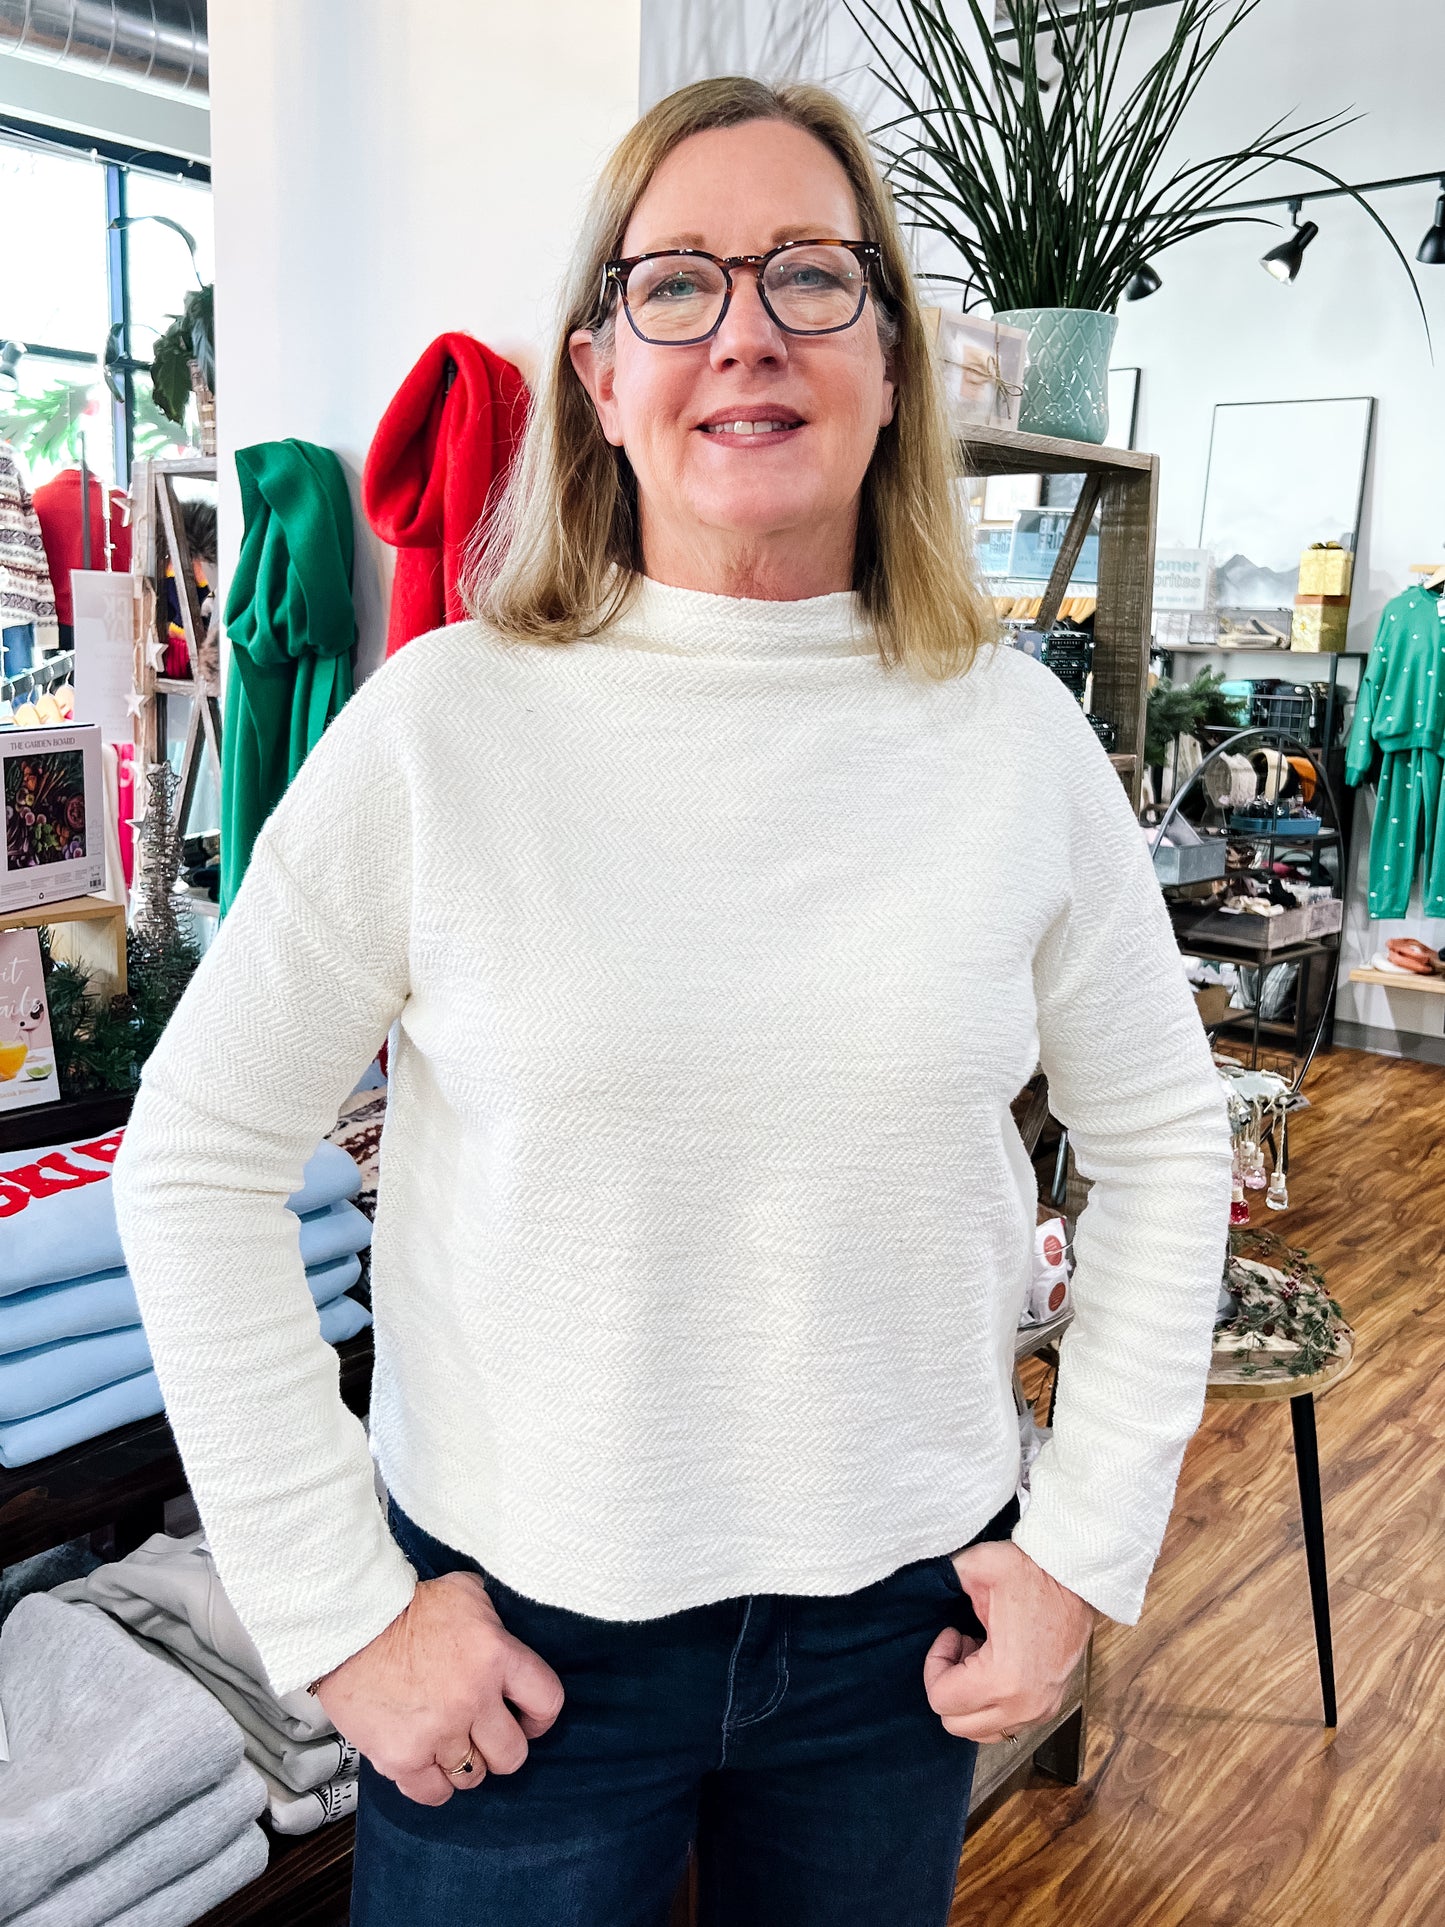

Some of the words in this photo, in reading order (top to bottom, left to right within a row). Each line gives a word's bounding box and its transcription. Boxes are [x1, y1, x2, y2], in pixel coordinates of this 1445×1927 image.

[1039, 517, 1071, 534] BLA
[1155, 559, 1201, 573] omer
[1154, 572, 1201, 589] orites
[10, 741, 23, 750] THE
[24, 739, 52, 749] GARDEN
[53, 737, 76, 746] BOARD
[0, 957, 30, 985] it
[0, 985, 43, 1018] ails
